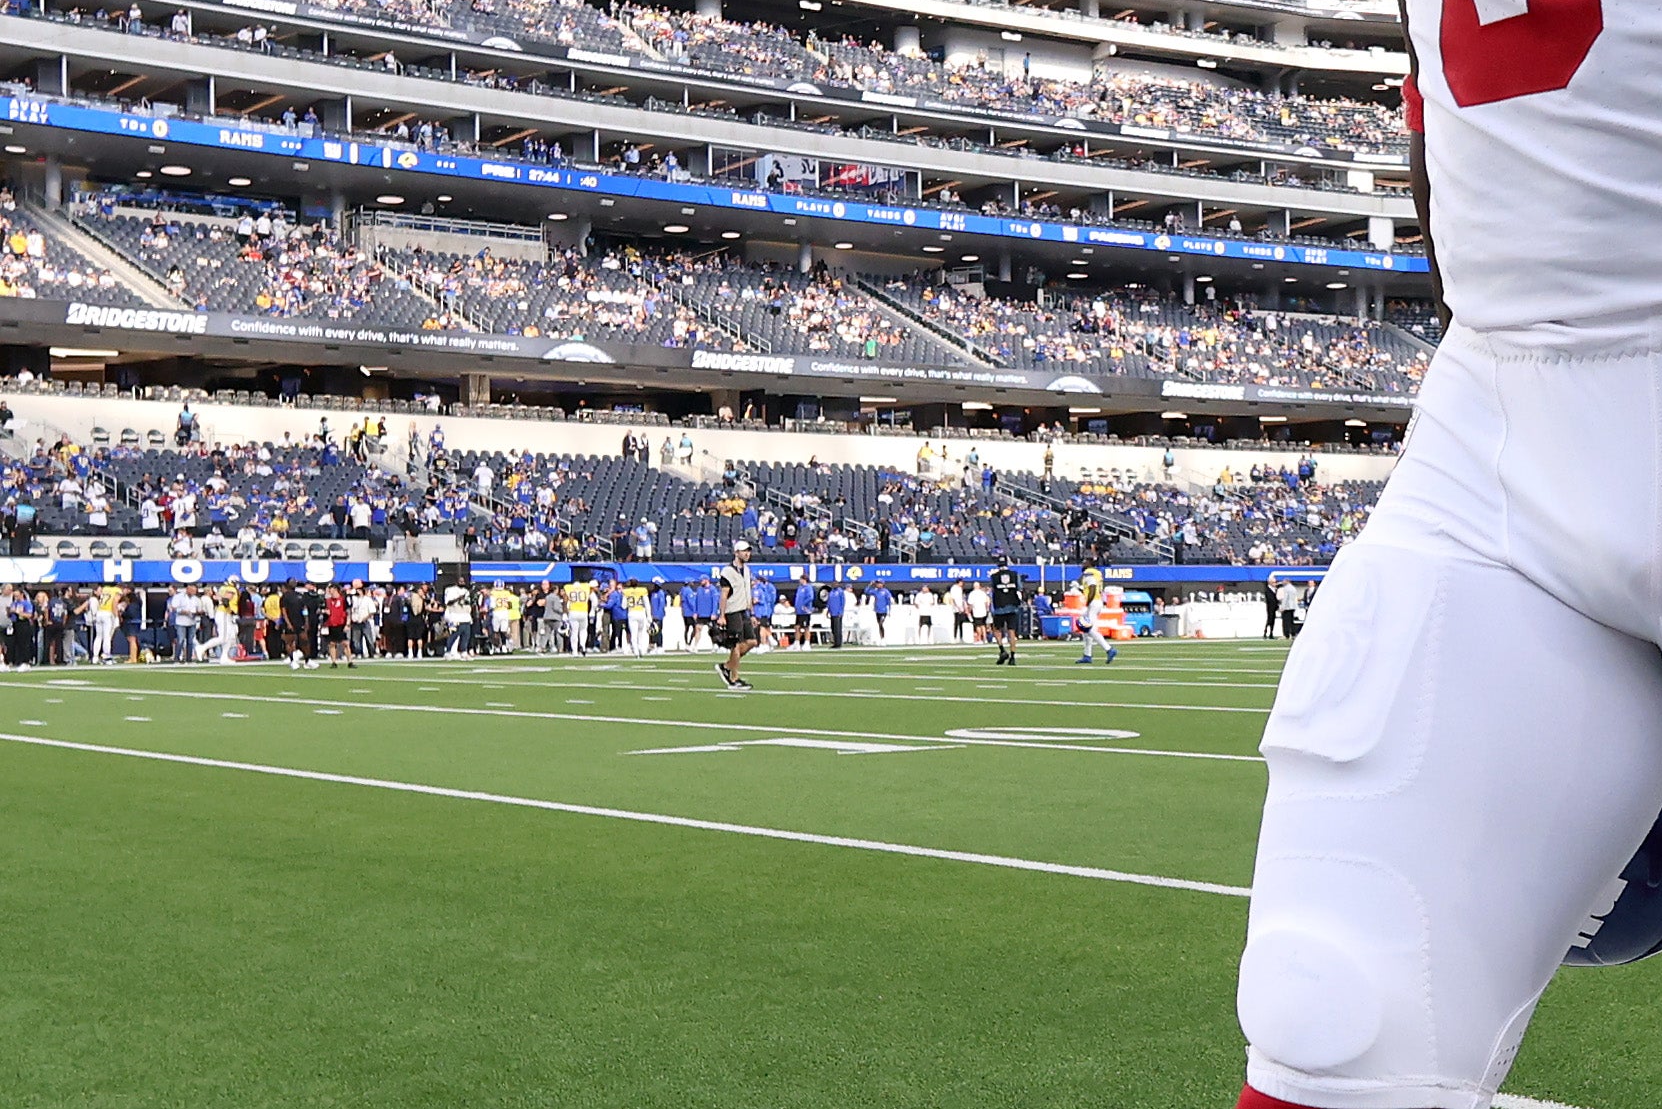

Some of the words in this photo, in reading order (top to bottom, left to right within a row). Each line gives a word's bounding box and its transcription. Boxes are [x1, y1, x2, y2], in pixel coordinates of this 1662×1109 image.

[220, 130, 263, 148] RAMS
[528, 169, 560, 183] 27:44
[732, 192, 767, 207] RAMS
[66, 303, 207, 333] BRIDGESTONE
[231, 320, 296, 335] Confidence
[298, 325, 323, 337] with
[325, 328, 356, 341] every
[357, 329, 387, 342] drive,
[389, 331, 420, 344] that's
[421, 334, 447, 346] what
[449, 336, 477, 349] really
[478, 339, 519, 351] matters.
[691, 350, 795, 373] BRIDGESTONE
[811, 361, 859, 374] Confidence
[861, 364, 879, 374] with
[880, 367, 903, 378] every
[904, 366, 927, 379] drive,
[928, 369, 951, 379] that's
[953, 371, 972, 380] what
[974, 372, 994, 383] really
[996, 374, 1028, 384] matters.
[103, 559, 394, 583] HOUSE
